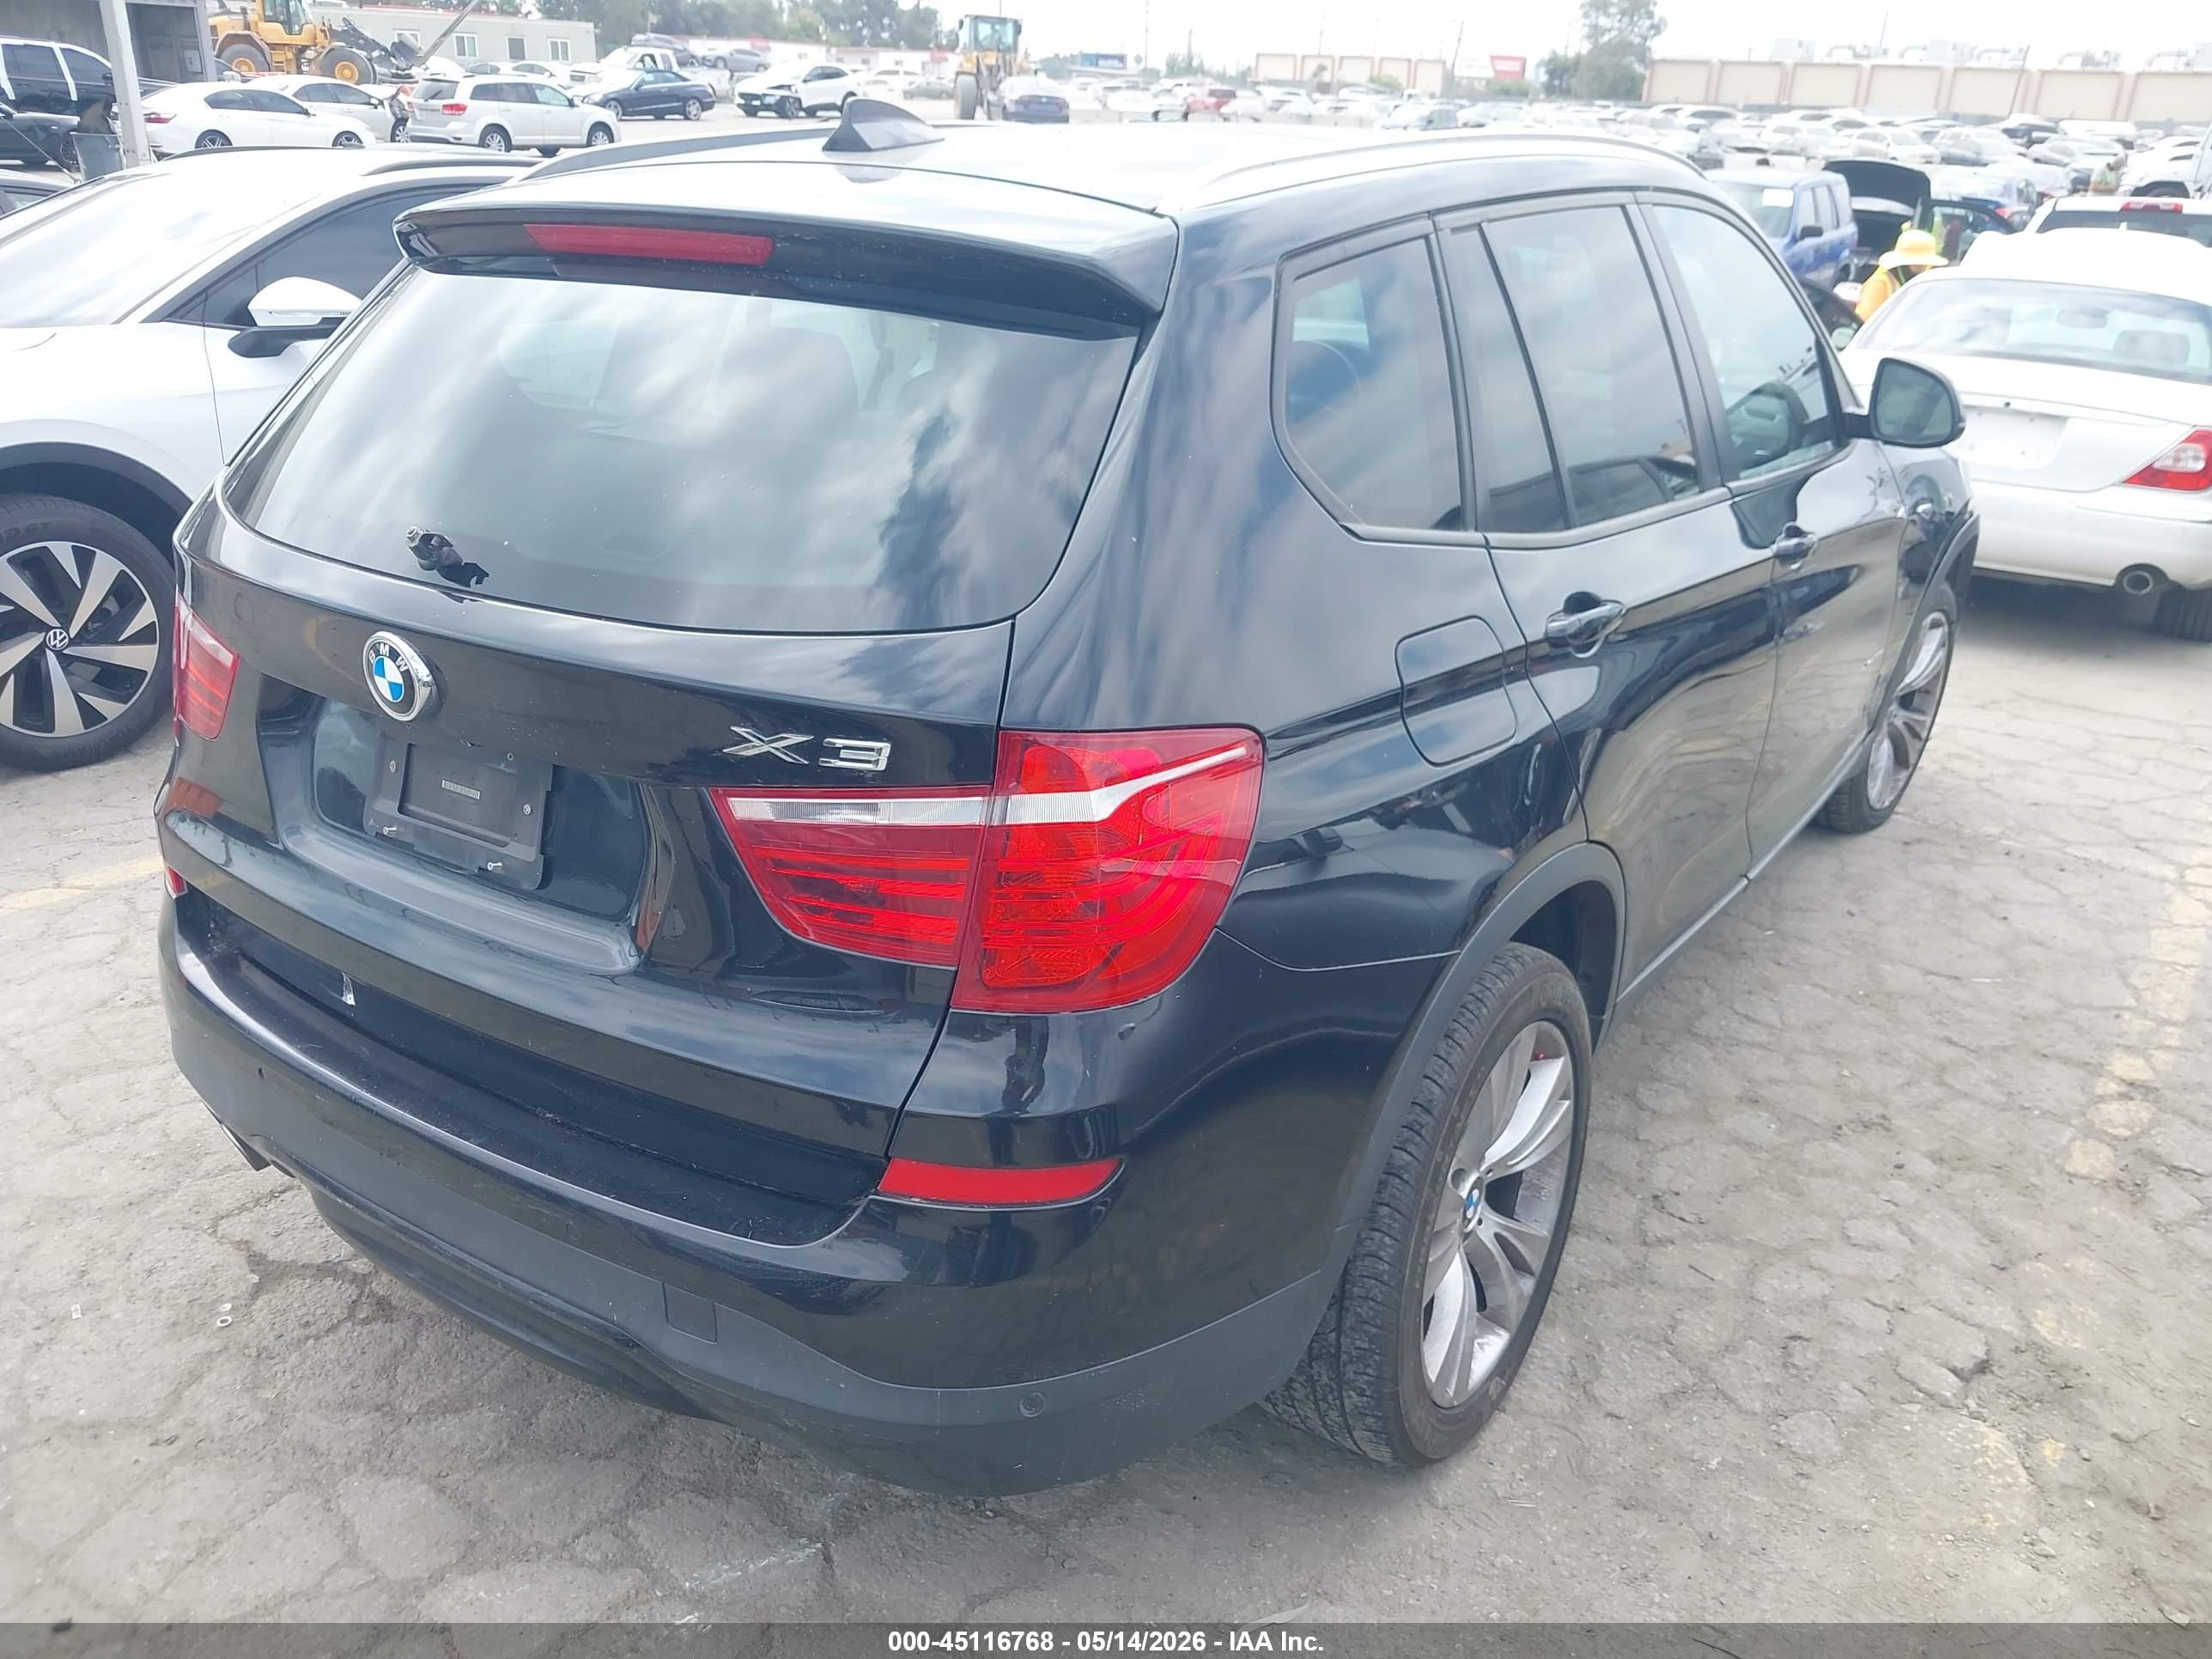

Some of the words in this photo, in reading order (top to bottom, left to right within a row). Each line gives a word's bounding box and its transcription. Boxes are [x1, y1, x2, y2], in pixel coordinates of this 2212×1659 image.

[46, 629, 69, 650] VW
[368, 641, 410, 672] BMW
[722, 726, 890, 771] X3
